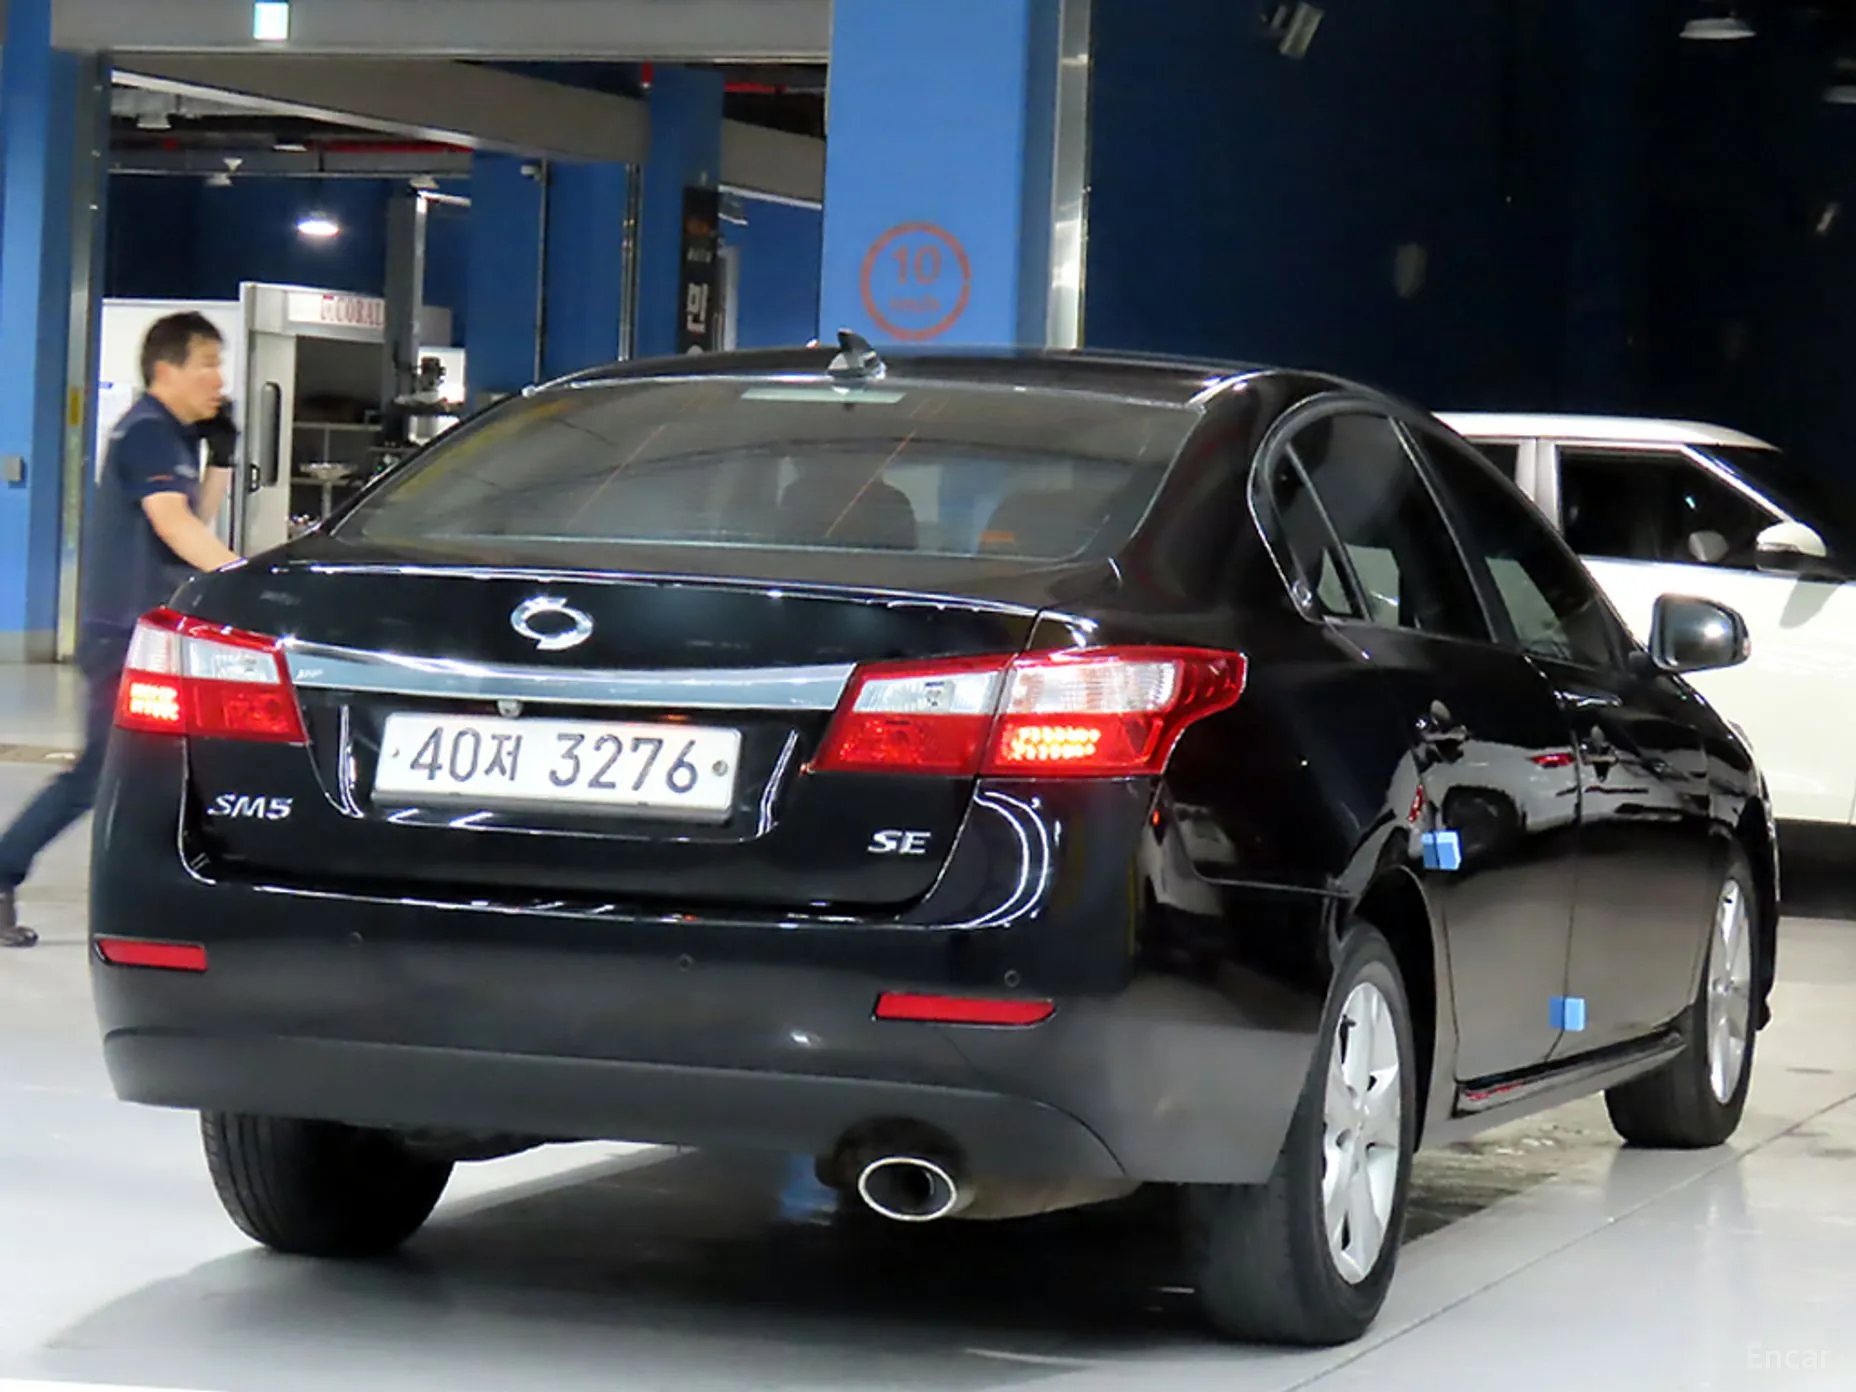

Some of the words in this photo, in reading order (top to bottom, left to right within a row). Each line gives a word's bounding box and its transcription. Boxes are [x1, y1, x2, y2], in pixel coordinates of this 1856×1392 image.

[892, 244, 941, 285] 10
[409, 726, 524, 783] 40저
[549, 733, 700, 794] 3276
[207, 794, 293, 820] SM5
[867, 830, 932, 854] SE
